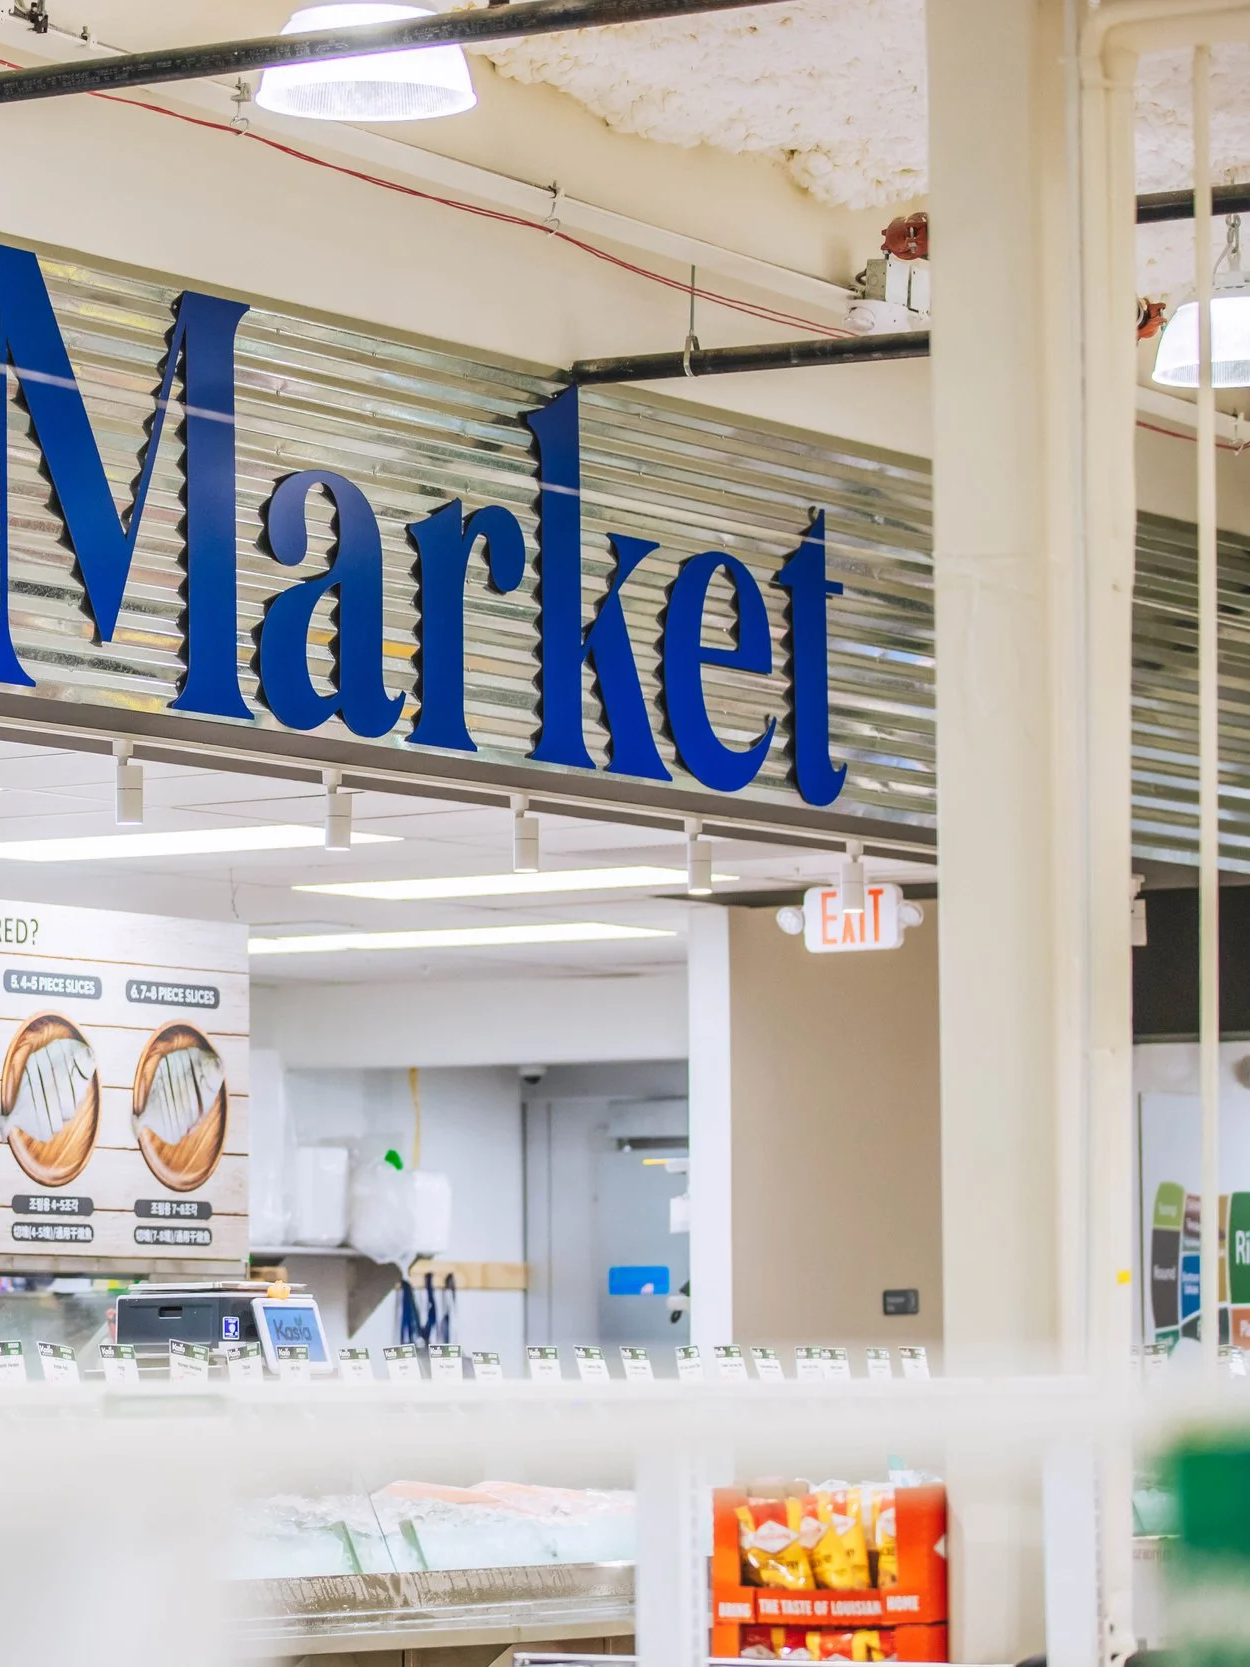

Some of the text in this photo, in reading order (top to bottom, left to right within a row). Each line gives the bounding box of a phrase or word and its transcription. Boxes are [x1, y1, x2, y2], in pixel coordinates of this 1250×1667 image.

[821, 888, 884, 945] EXIT
[38, 976, 65, 992] PIECE
[65, 978, 96, 995] SLICES
[158, 987, 184, 1002] PIECE
[185, 988, 215, 1005] SLICES
[813, 1600, 829, 1615] OF
